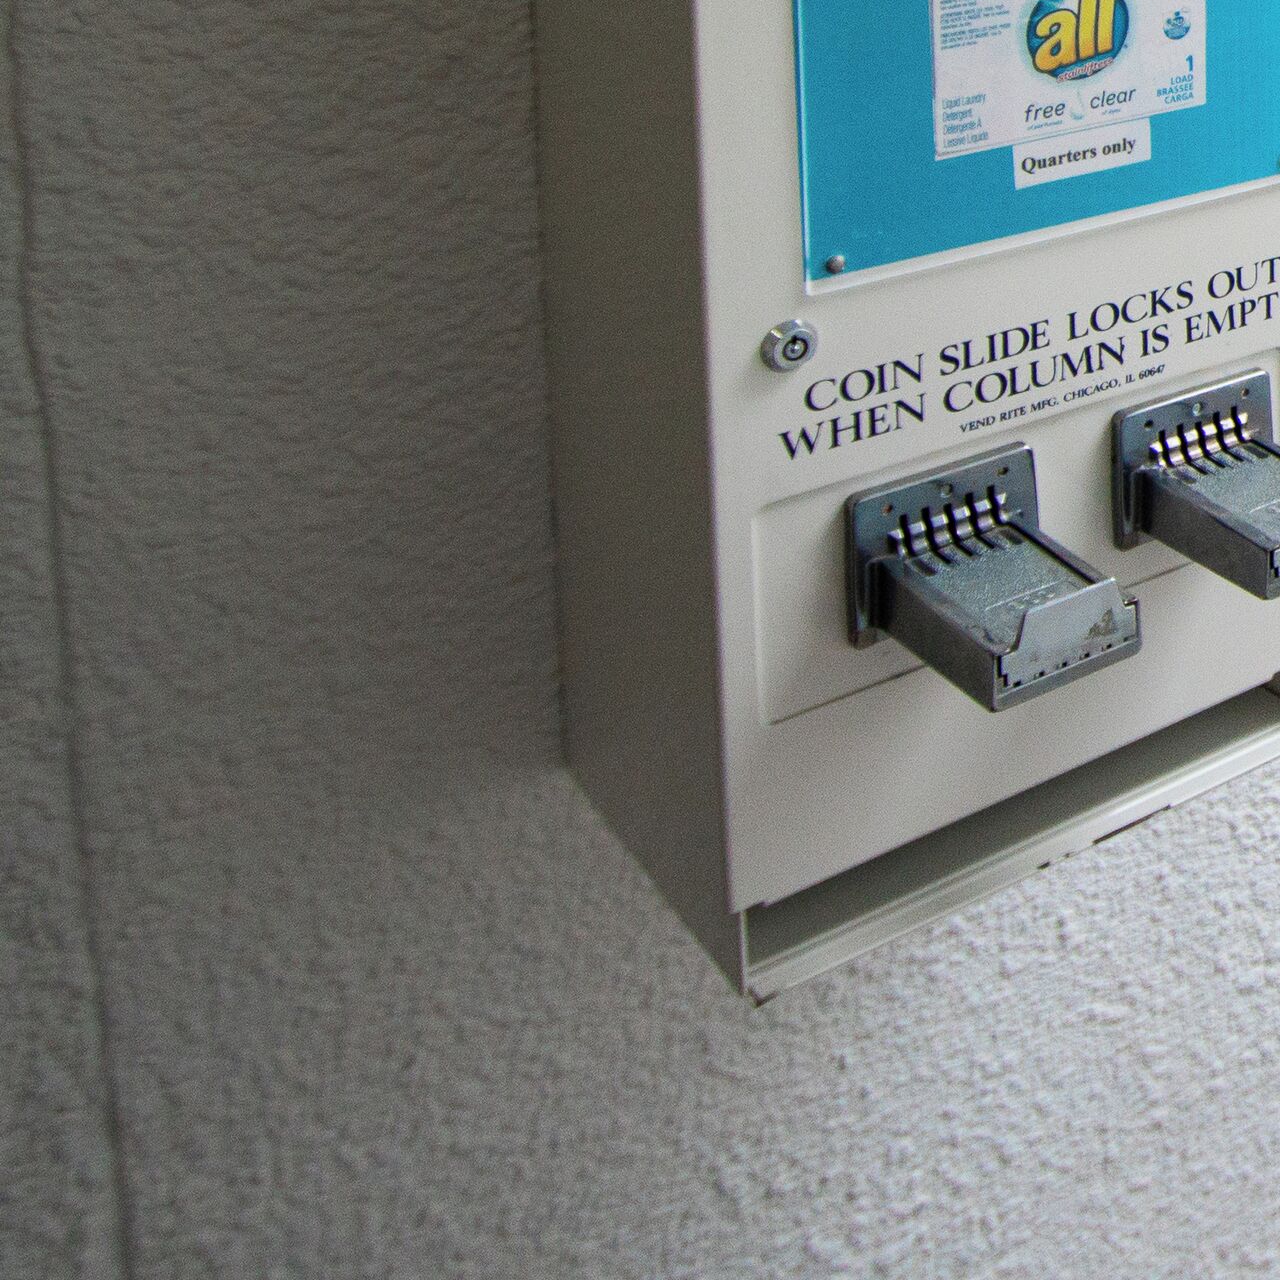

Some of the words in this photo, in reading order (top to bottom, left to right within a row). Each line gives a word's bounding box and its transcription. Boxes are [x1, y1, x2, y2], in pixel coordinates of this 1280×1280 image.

[1185, 54, 1194, 72] 1
[1170, 73, 1194, 86] LOAD
[1090, 89, 1137, 109] clear
[1164, 92, 1194, 105] CARGA
[1024, 103, 1066, 122] free
[1021, 146, 1098, 175] Quarters
[1101, 137, 1137, 156] only
[804, 352, 925, 413] COIN
[939, 319, 1050, 378] SLIDE
[1066, 280, 1195, 340] LOCKS
[779, 392, 926, 462] WHEN
[942, 334, 1126, 414] COLUMN
[1140, 321, 1170, 357] IS
[959, 414, 996, 434] VEND
[1000, 405, 1027, 423] RITE
[1030, 396, 1060, 415] MFG.
[1063, 377, 1122, 404] CHICAGO,
[1125, 372, 1136, 385] IL
[1138, 363, 1166, 381] 60647
